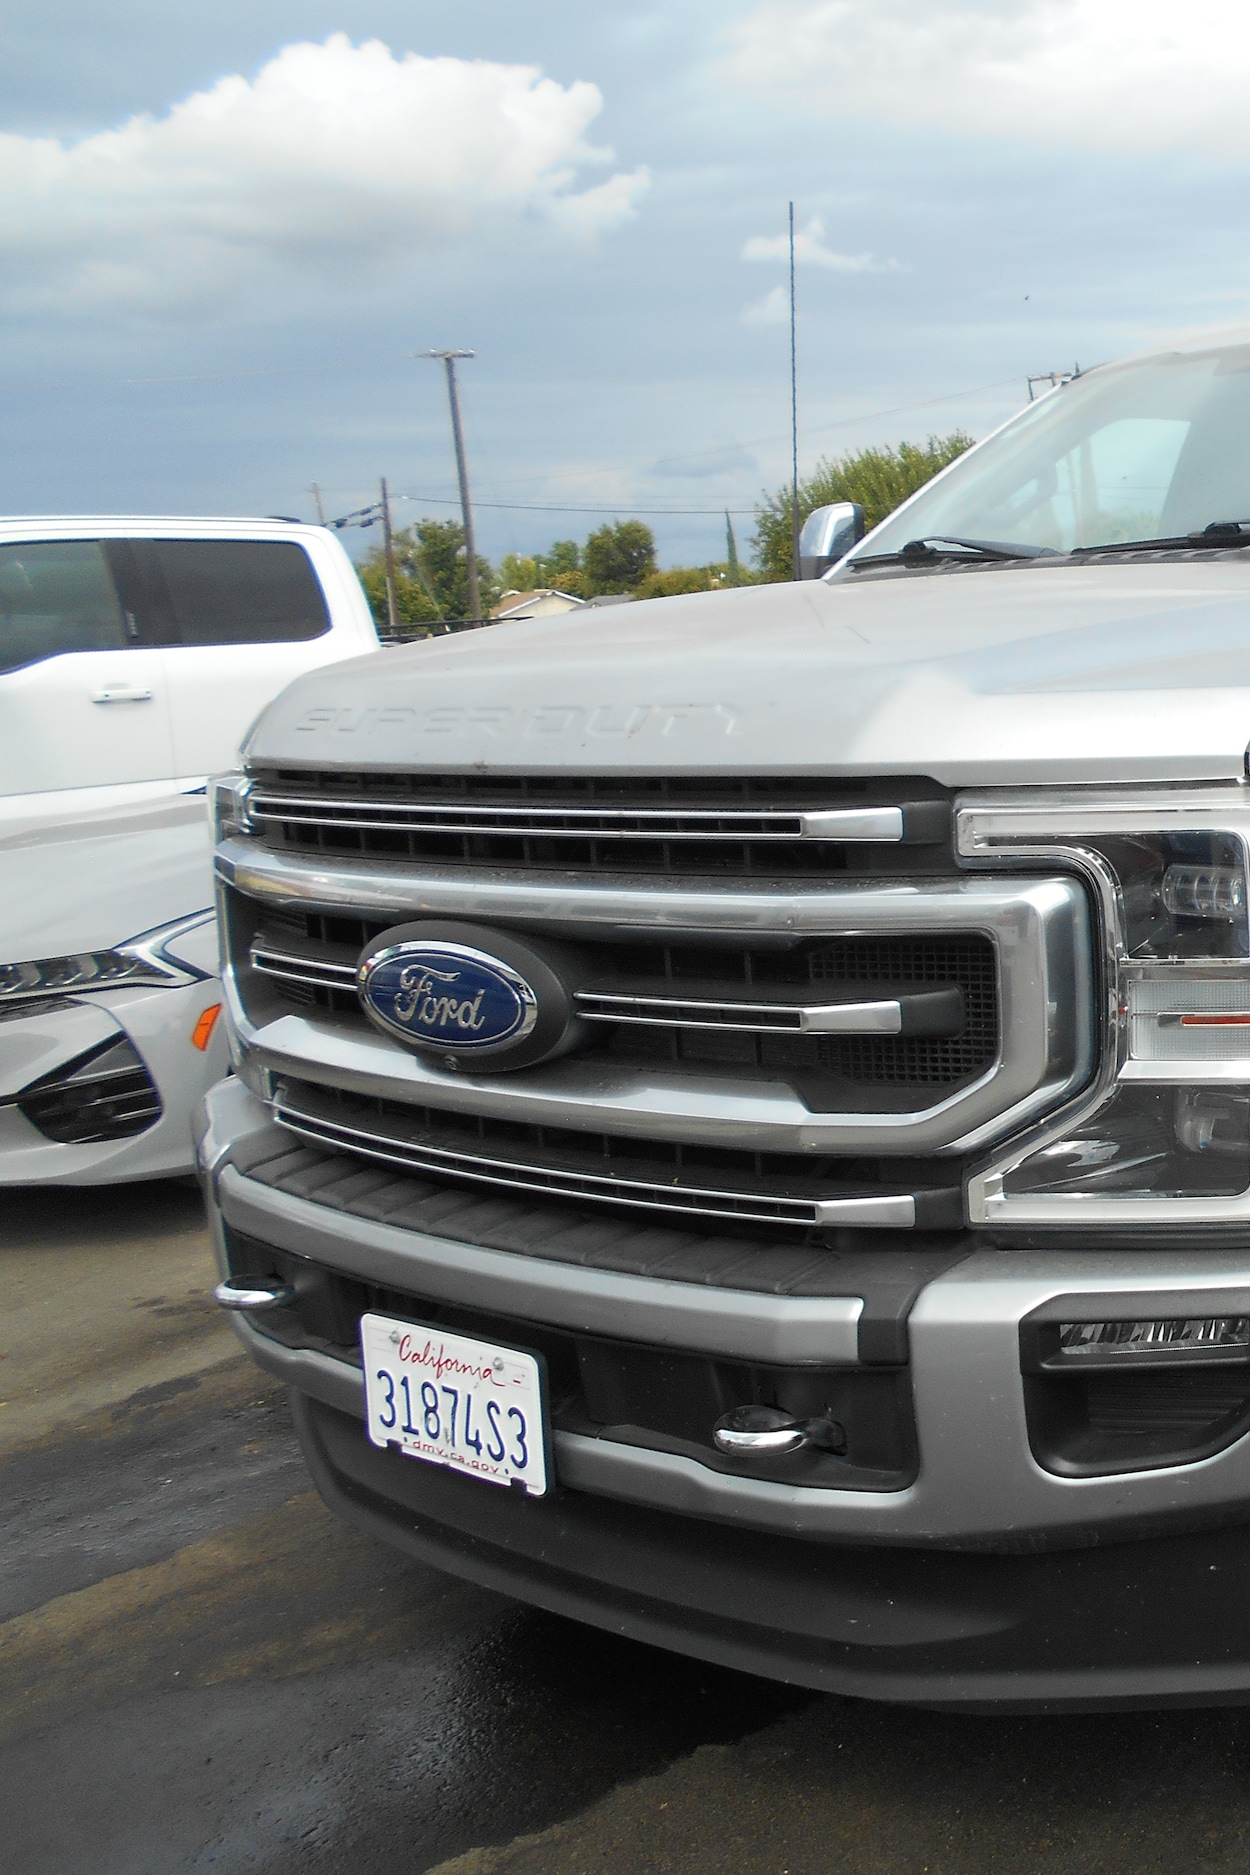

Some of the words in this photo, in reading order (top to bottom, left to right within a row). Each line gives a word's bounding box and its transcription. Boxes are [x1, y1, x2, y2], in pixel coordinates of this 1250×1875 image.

[296, 707, 514, 737] SUPER
[524, 704, 744, 737] DUTY
[394, 963, 486, 1031] Ford
[399, 1334, 506, 1387] California
[377, 1369, 529, 1469] 31874S3
[413, 1439, 500, 1474] dmv.ca.gov
